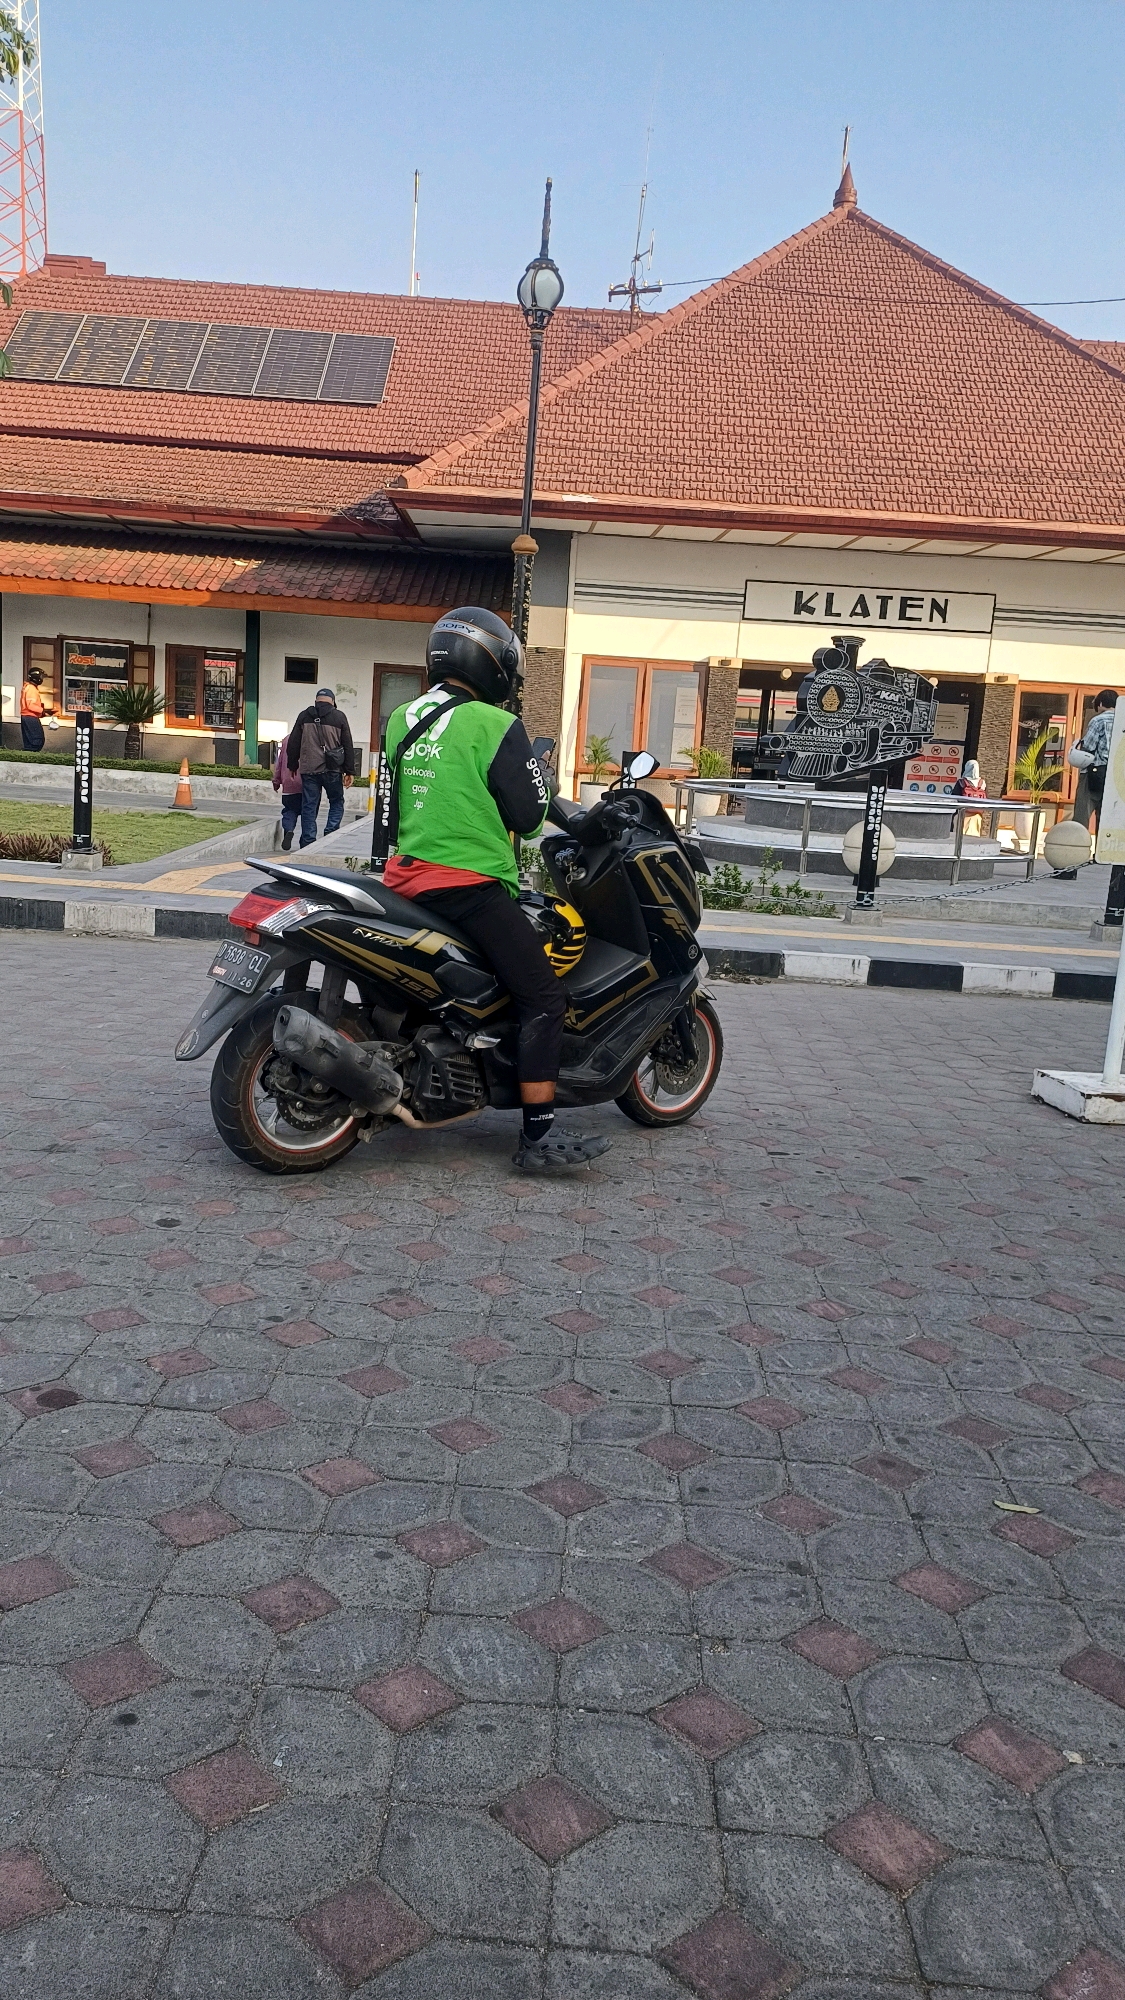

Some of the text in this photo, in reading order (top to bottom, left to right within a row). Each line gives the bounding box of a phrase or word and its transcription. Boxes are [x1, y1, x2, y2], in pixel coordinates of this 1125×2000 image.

[793, 590, 949, 624] KLATEN
[879, 690, 900, 702] KAI
[525, 757, 549, 804] gopay
[224, 945, 248, 965] 5638
[248, 955, 264, 974] CL
